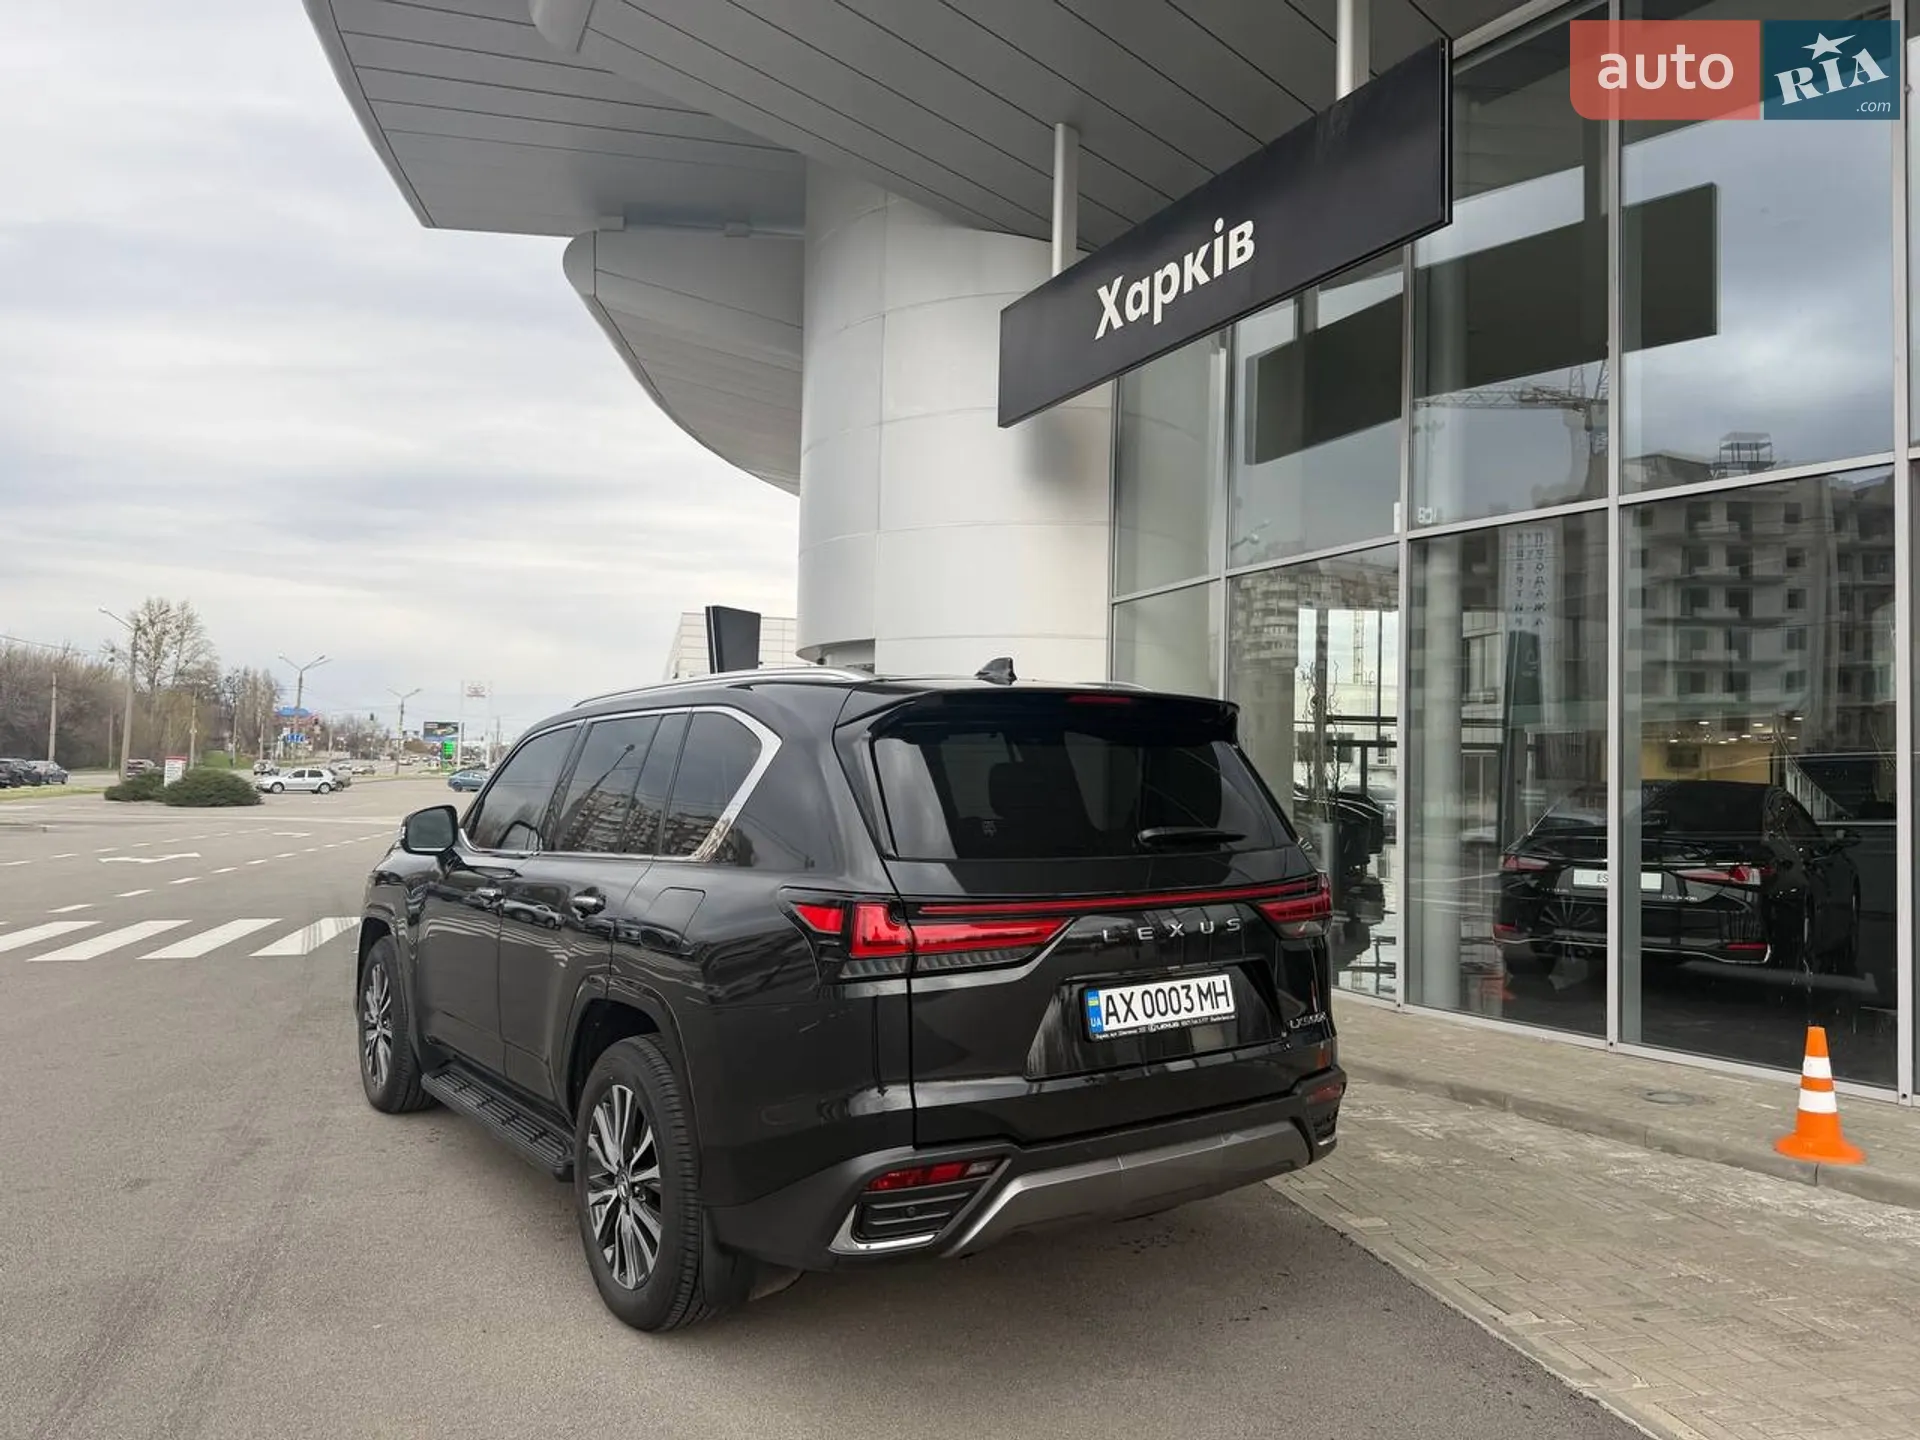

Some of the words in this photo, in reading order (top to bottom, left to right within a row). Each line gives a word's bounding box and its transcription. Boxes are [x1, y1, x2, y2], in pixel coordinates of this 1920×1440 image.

[1094, 217, 1256, 340] Харків
[1102, 917, 1241, 942] LEXUS
[1105, 991, 1139, 1026] AX
[1141, 984, 1195, 1019] 0003
[1196, 979, 1231, 1012] MH
[1090, 1017, 1102, 1028] UA
